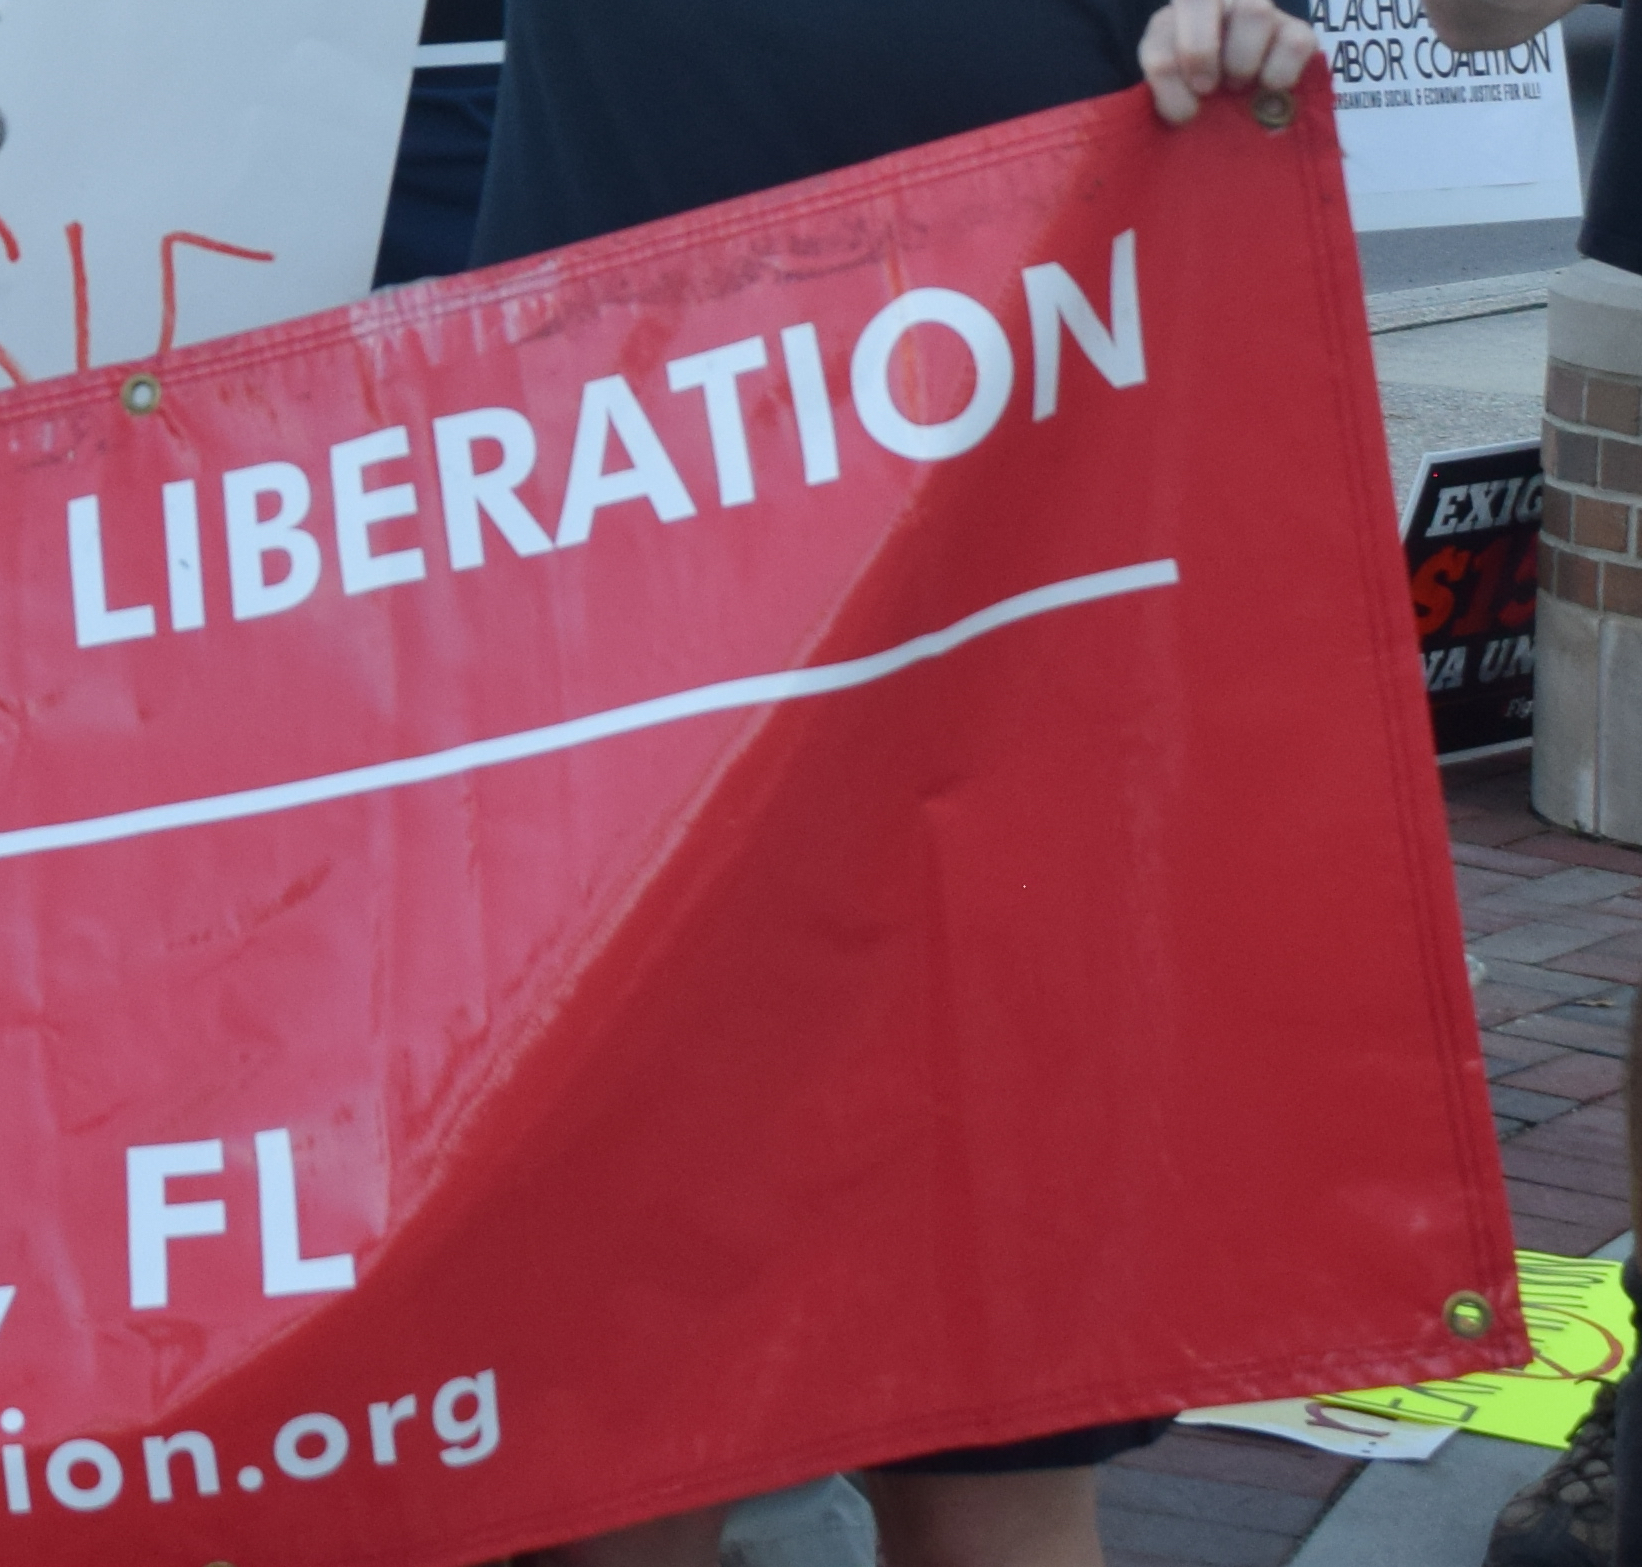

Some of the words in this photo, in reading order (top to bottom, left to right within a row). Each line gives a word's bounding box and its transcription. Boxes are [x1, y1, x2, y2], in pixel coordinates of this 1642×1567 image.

[1331, 37, 1408, 83] ABOR
[67, 228, 1149, 650] LIBERATION
[126, 1128, 357, 1311] FL
